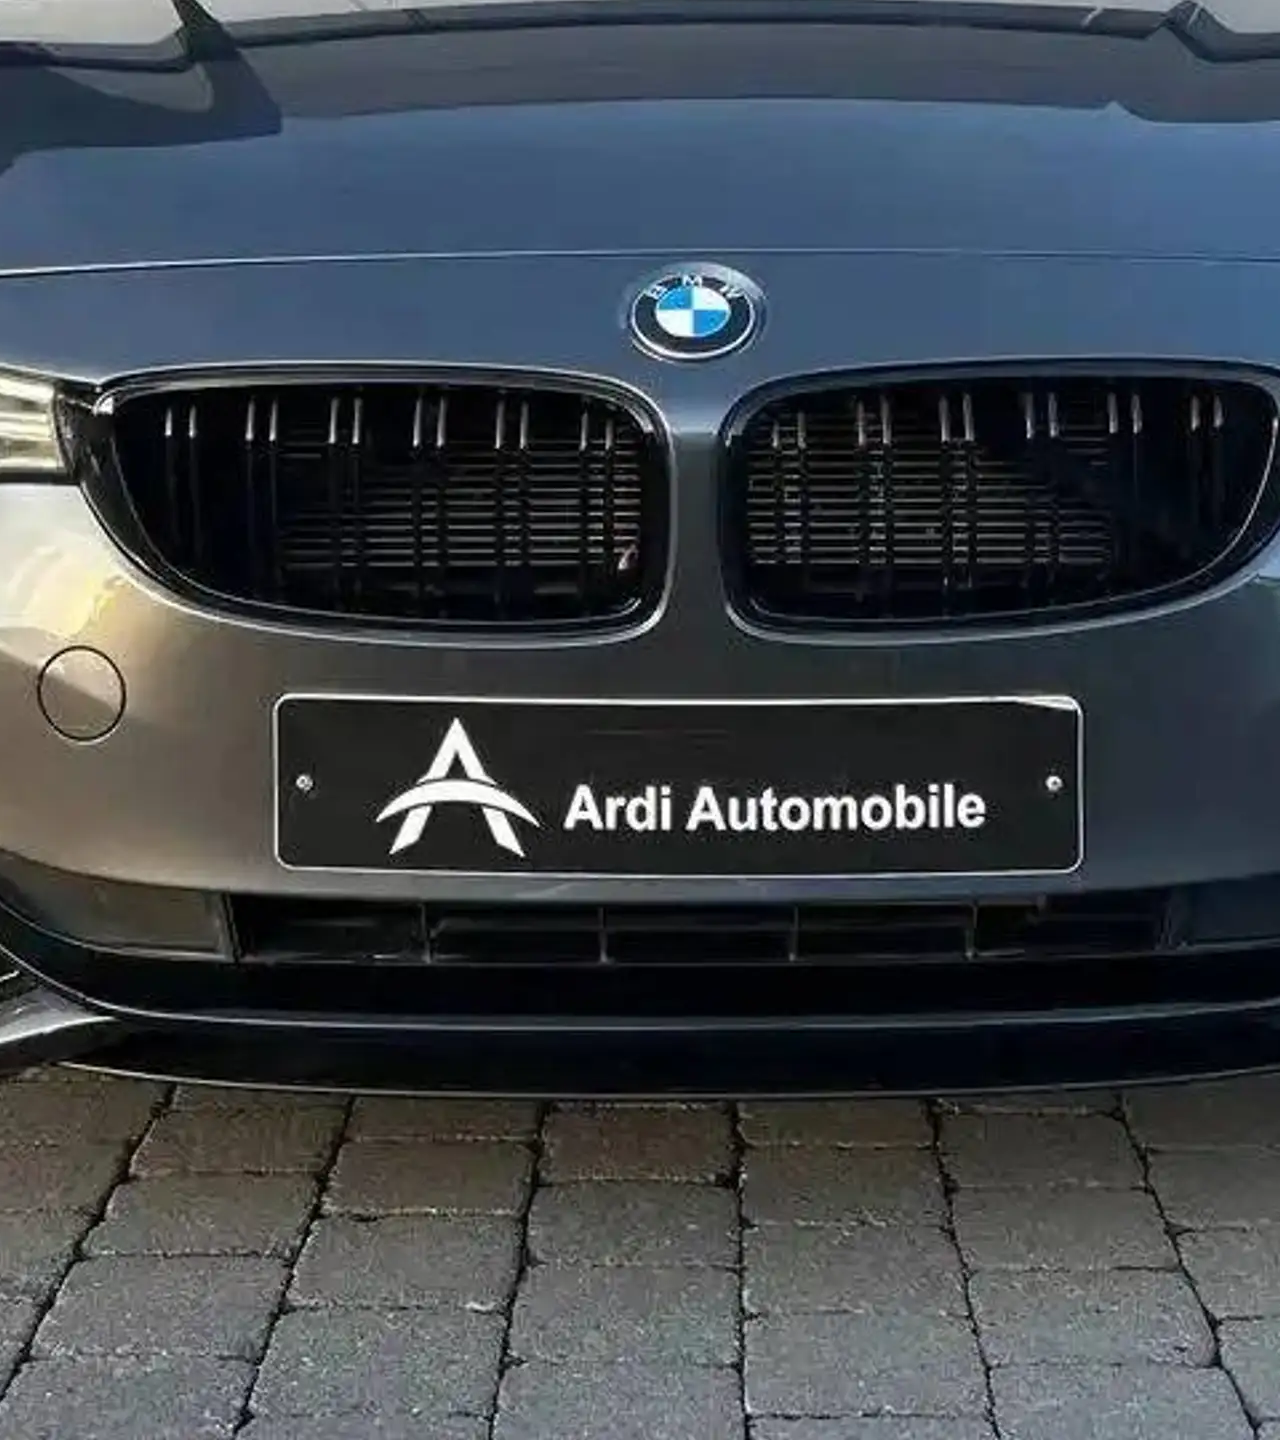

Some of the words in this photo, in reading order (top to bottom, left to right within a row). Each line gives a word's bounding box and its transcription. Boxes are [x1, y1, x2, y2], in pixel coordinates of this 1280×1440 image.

[645, 274, 744, 300] BMW
[562, 782, 673, 833] Ardi
[684, 781, 988, 833] Automobile
